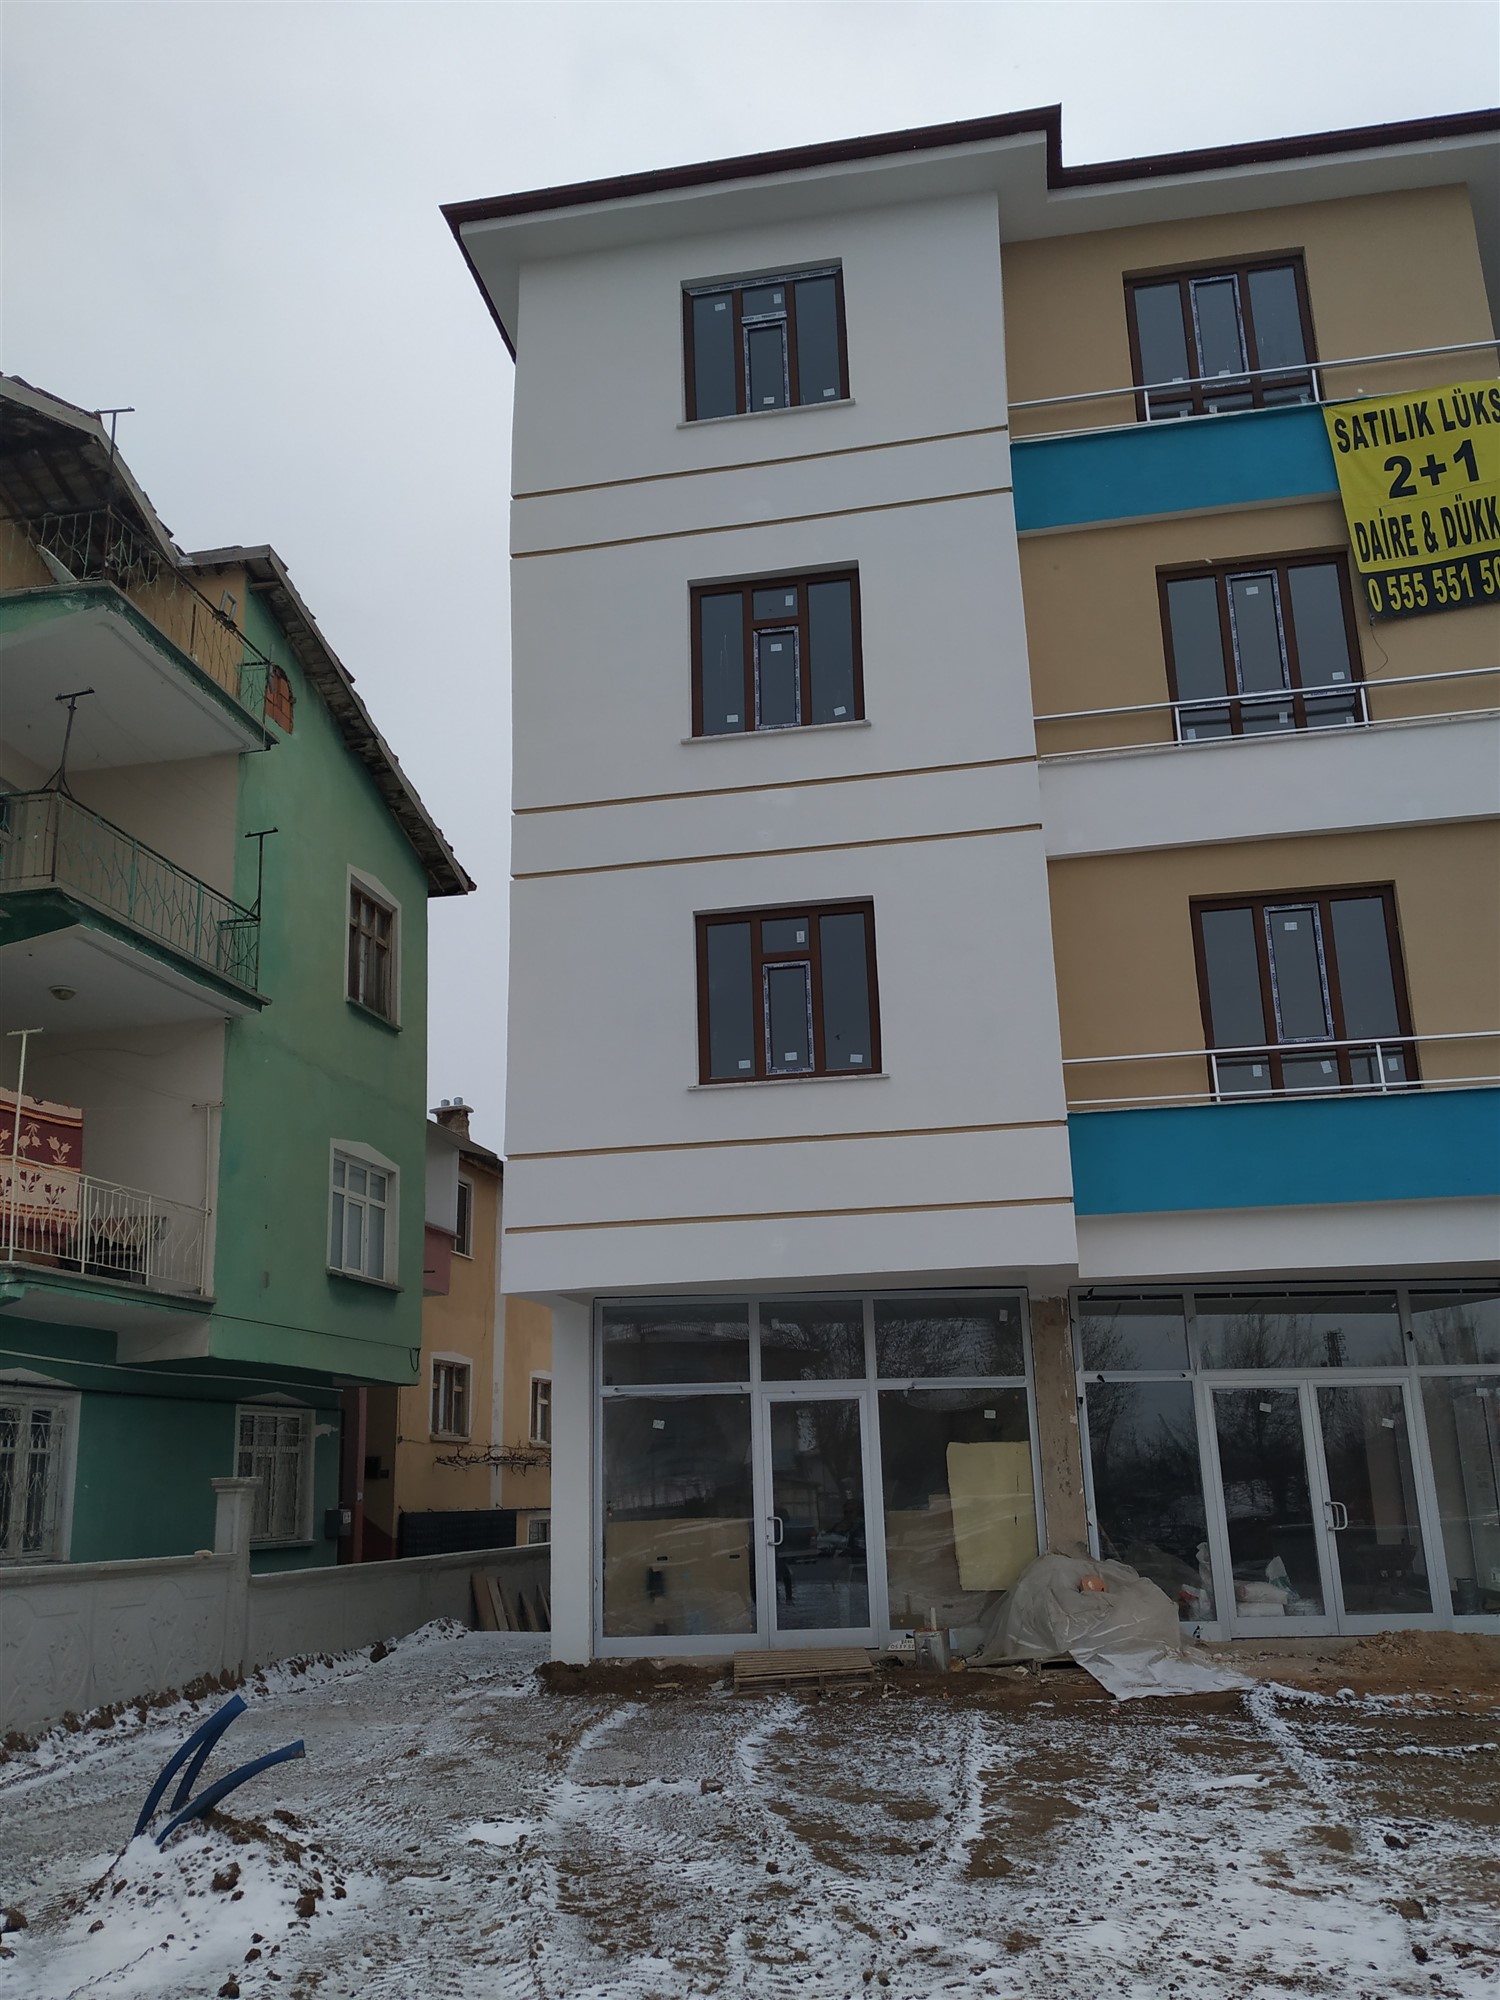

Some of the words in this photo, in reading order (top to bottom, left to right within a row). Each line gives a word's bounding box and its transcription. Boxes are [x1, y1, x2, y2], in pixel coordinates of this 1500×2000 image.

[1334, 401, 1435, 453] SATILIK
[1437, 388, 1500, 432] LÜKS
[1384, 439, 1480, 499] 2+1
[1354, 508, 1419, 562] DAİRE
[1421, 511, 1439, 553] &
[1368, 578, 1383, 613] 0
[1386, 572, 1429, 611] 555
[1432, 563, 1474, 604] 551
